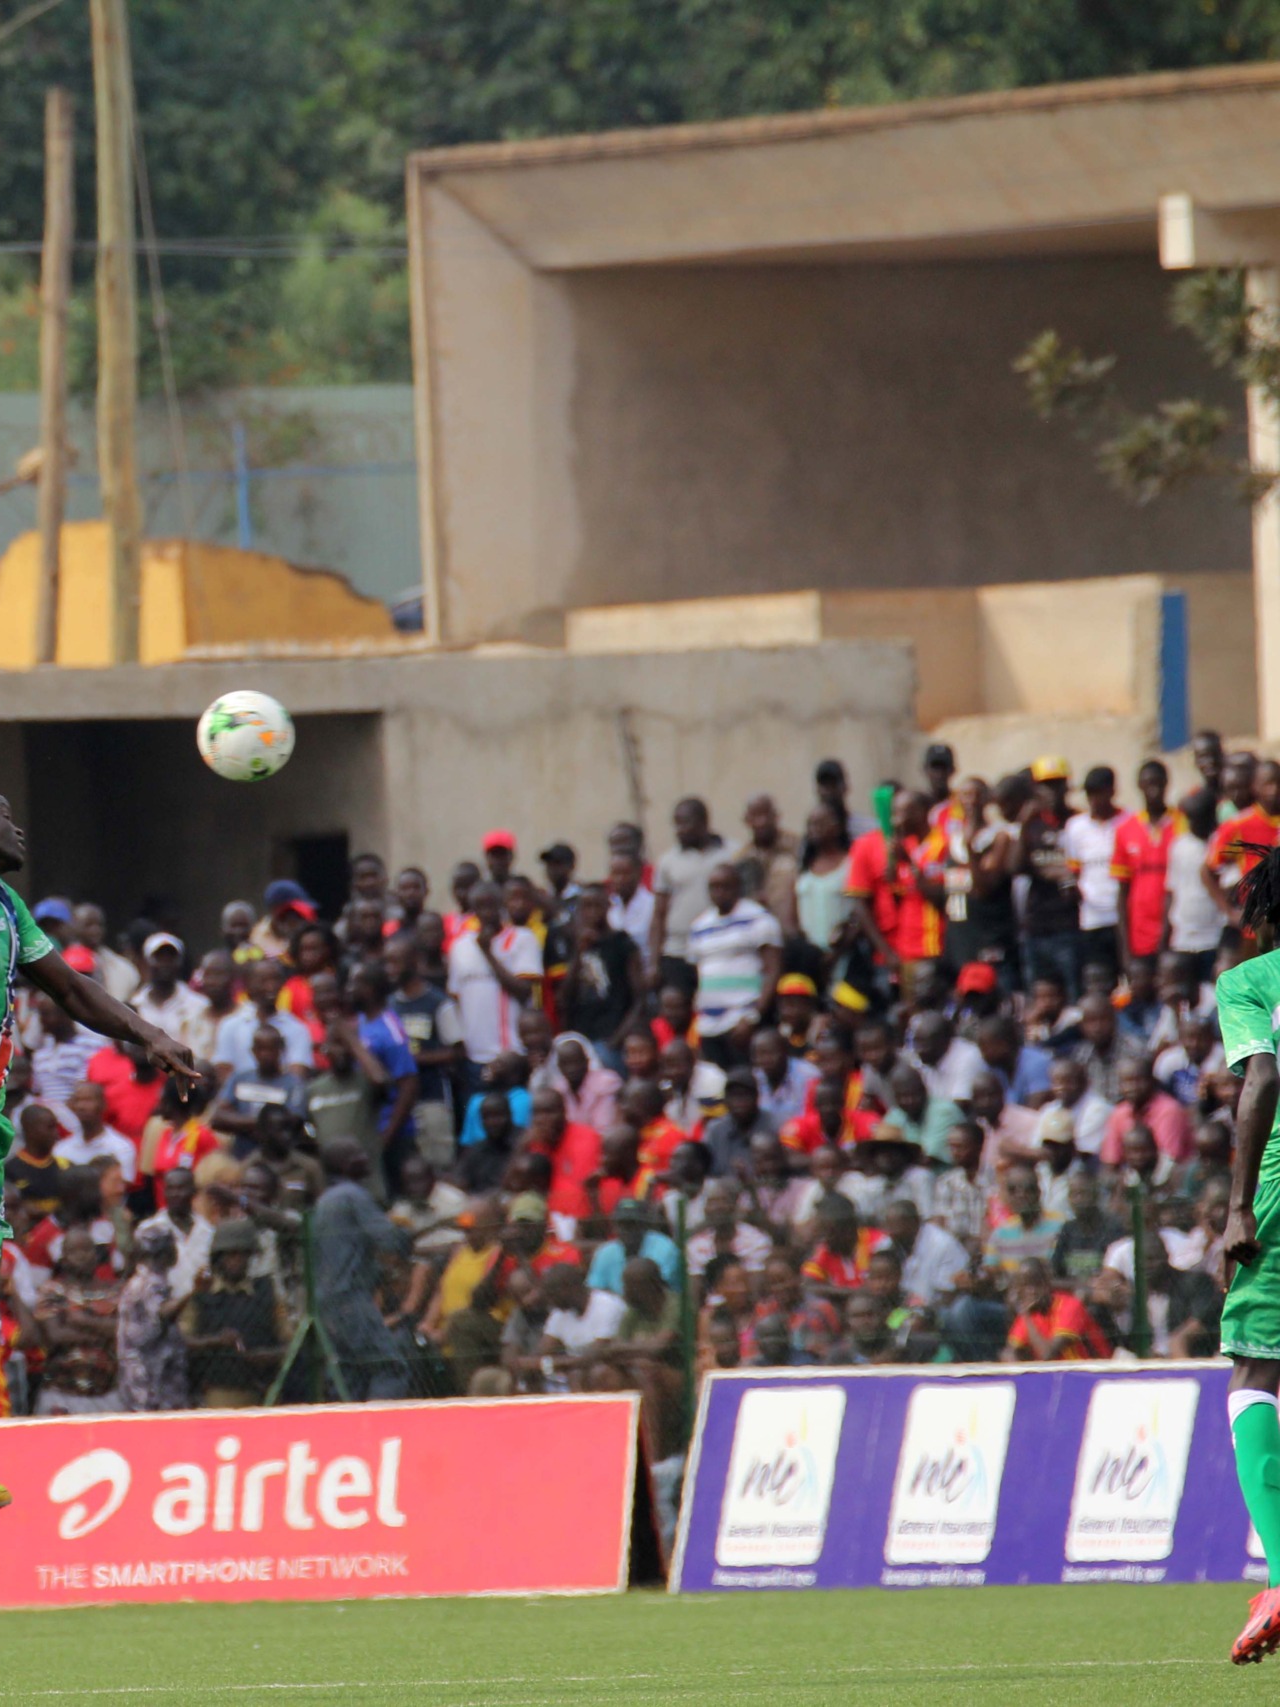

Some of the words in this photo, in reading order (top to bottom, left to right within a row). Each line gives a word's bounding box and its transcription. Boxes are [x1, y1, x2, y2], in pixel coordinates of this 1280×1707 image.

[152, 1435, 407, 1537] airtel
[35, 1565, 89, 1591] THE
[92, 1556, 274, 1588] SMARTPHONE
[276, 1553, 409, 1581] NETWORK
